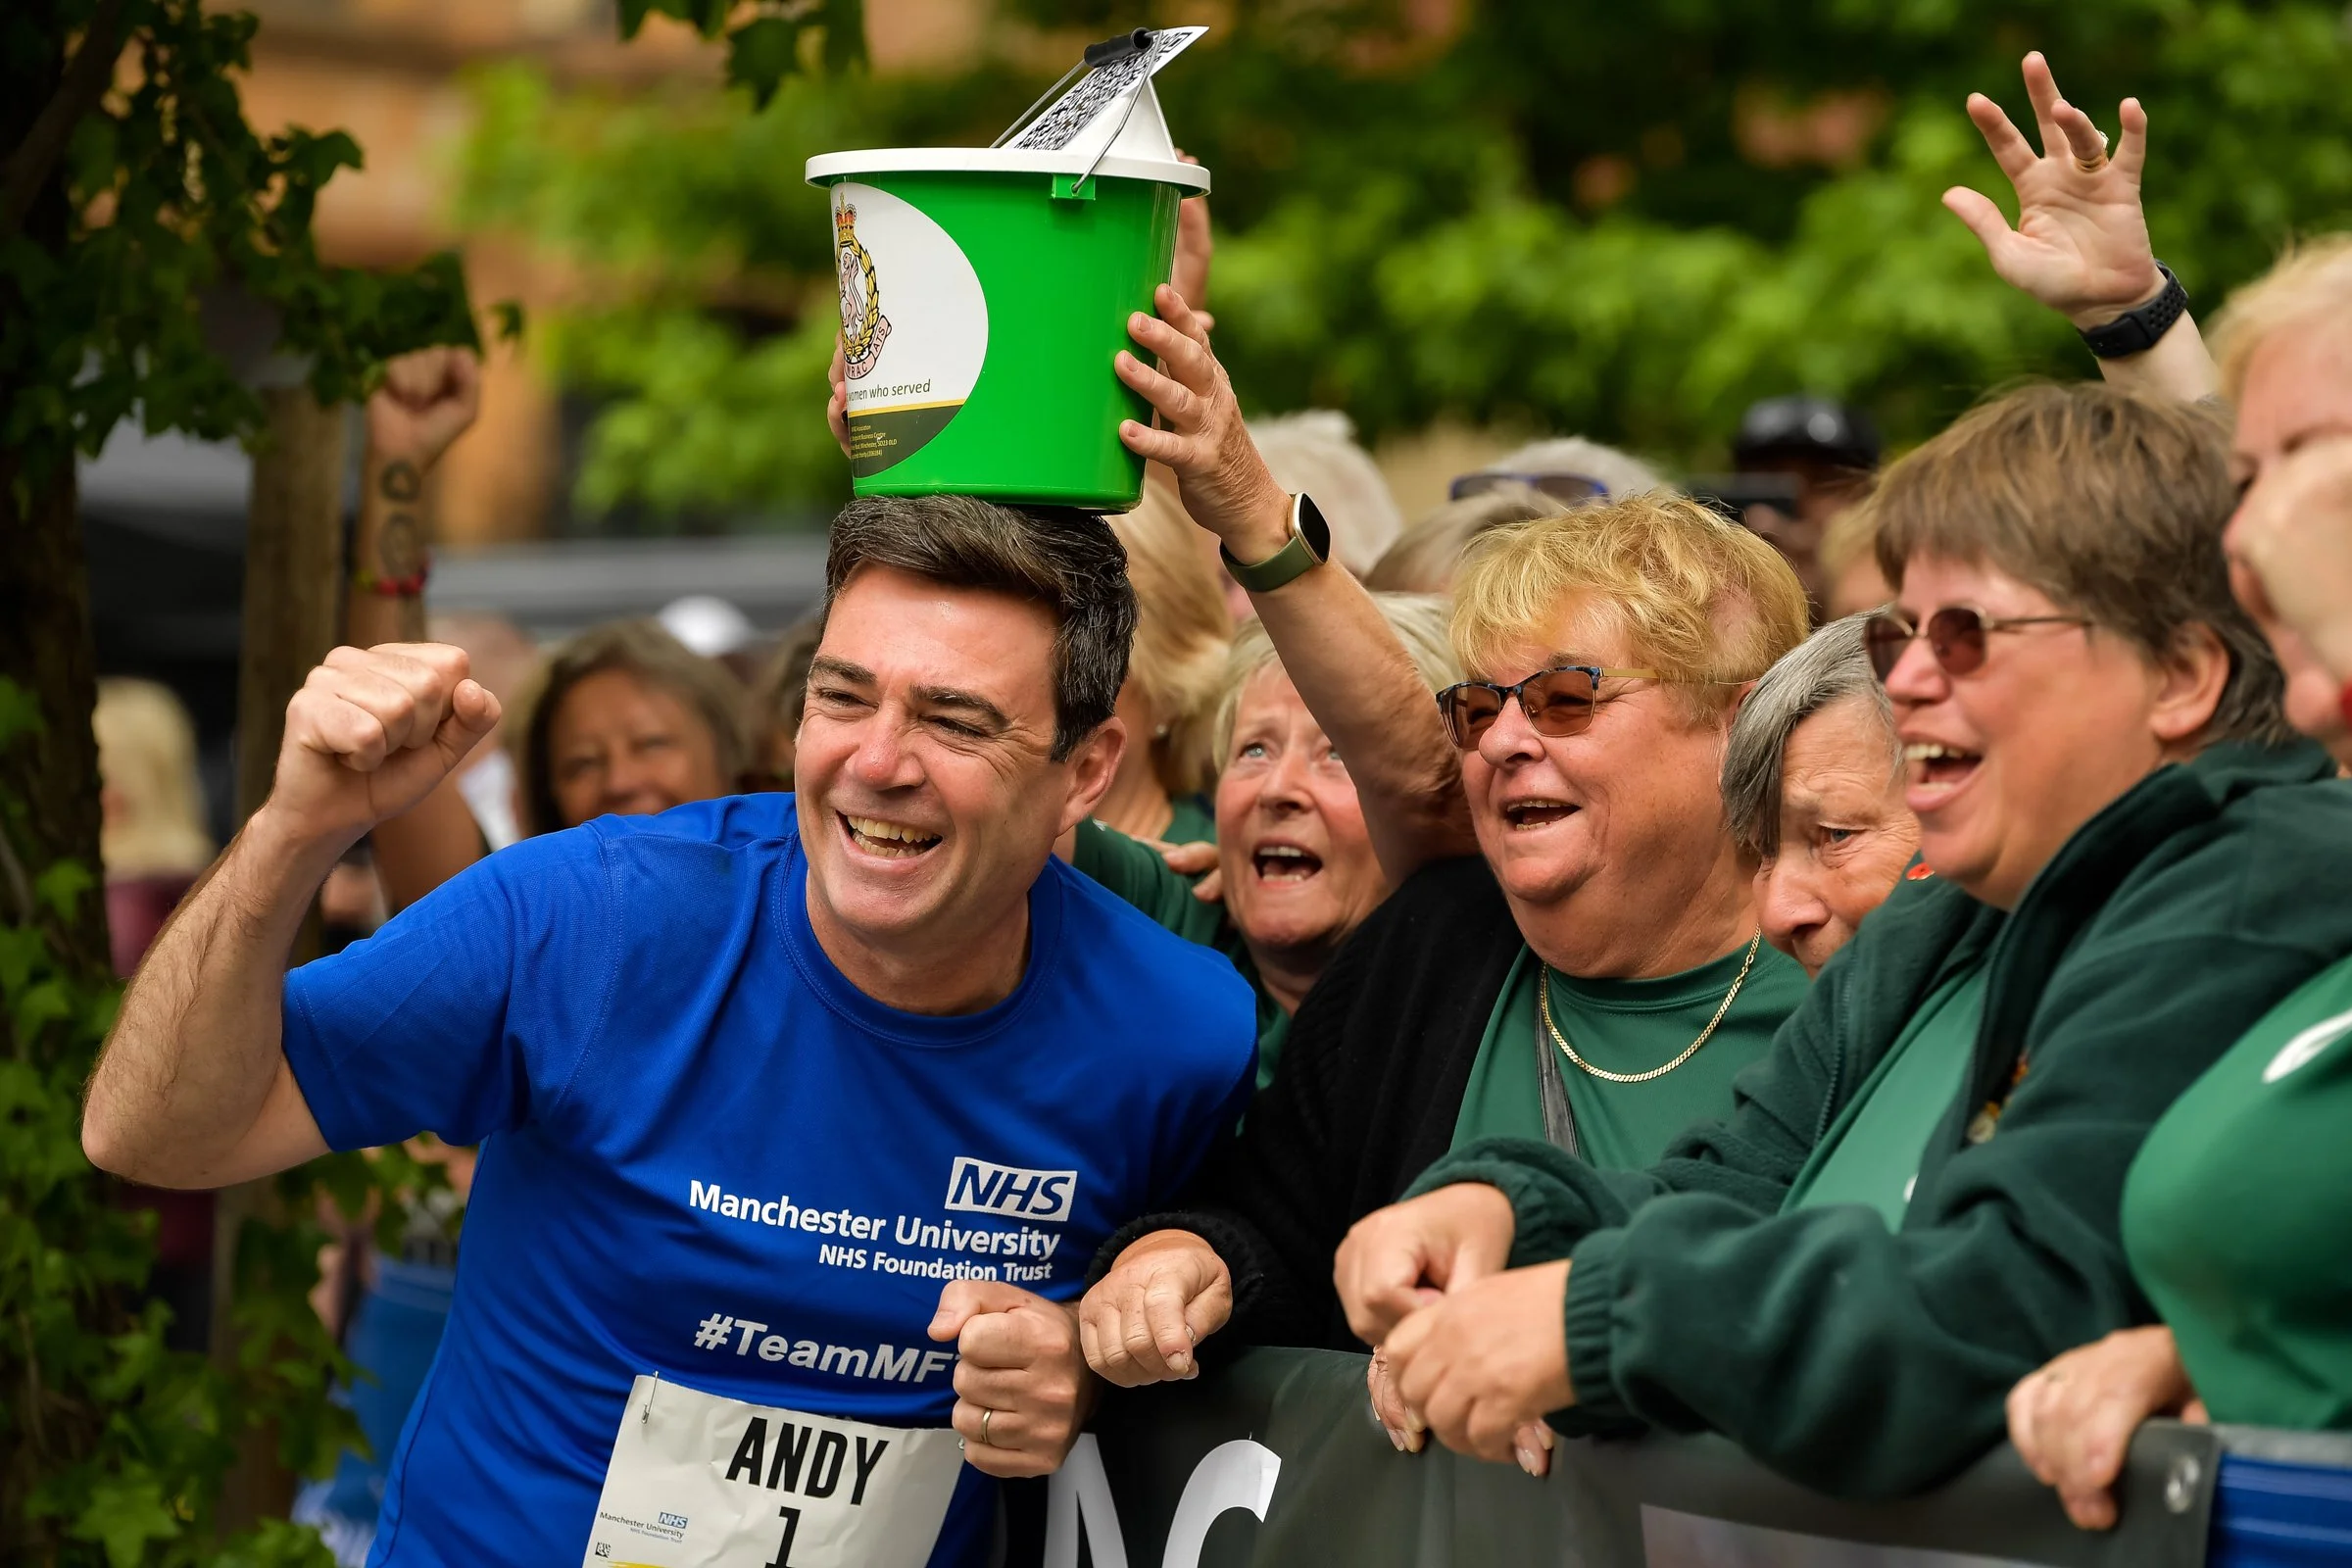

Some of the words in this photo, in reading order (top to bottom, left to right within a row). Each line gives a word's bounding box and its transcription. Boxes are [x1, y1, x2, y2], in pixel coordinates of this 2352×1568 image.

[873, 326, 886, 353] ATS
[869, 384, 889, 399] who
[892, 378, 931, 396] served
[950, 1162, 1070, 1216] NHS
[689, 1179, 887, 1242] Manchester
[894, 1215, 1061, 1261] University
[818, 1244, 867, 1269] NHS
[872, 1251, 998, 1282] Foundation
[1002, 1261, 1054, 1282] Trust
[694, 1311, 961, 1383] #TeamMF
[724, 1416, 890, 1505] ANDY
[599, 1511, 645, 1529] Manchester
[646, 1523, 684, 1540] University
[659, 1512, 687, 1529] NHS
[763, 1505, 802, 1568] 1
